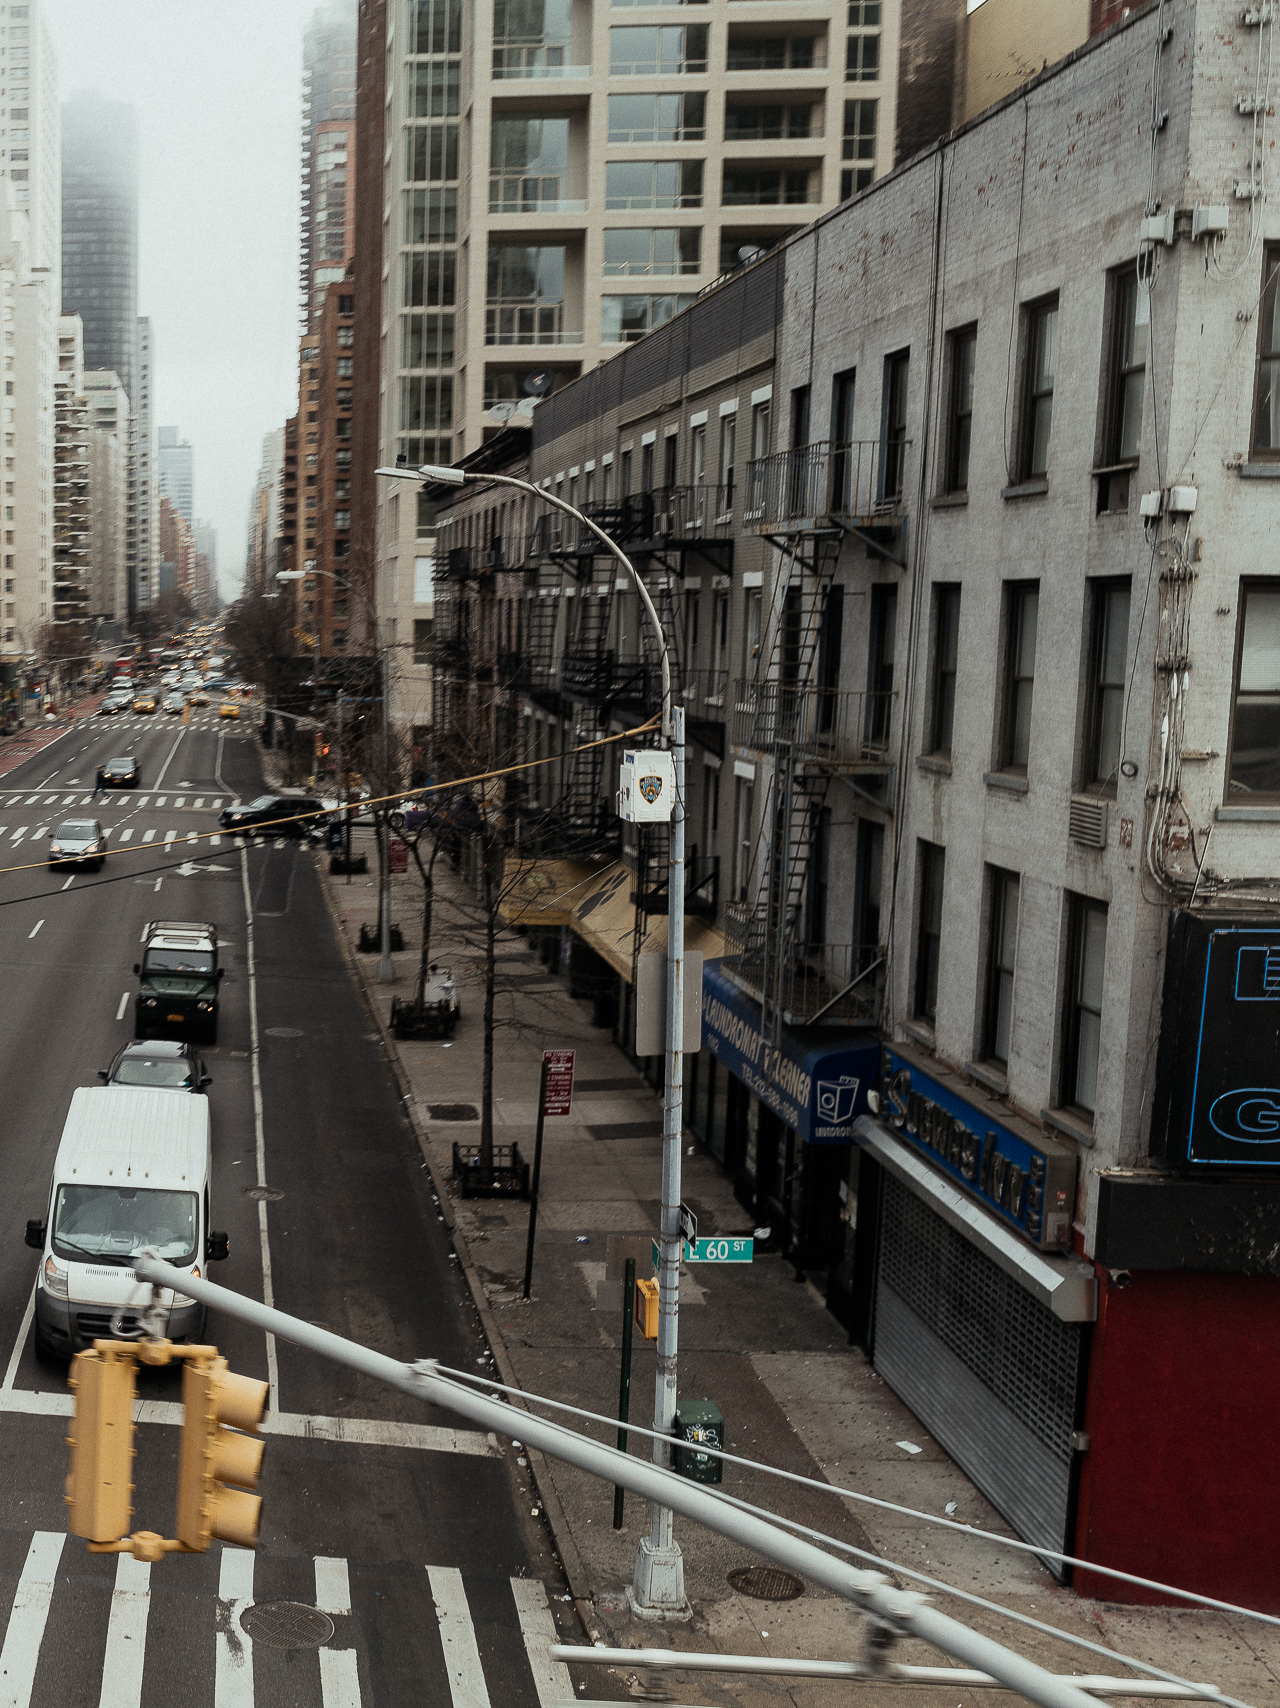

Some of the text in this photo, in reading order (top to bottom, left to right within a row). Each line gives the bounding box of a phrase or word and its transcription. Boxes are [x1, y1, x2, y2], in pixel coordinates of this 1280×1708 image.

[705, 994, 763, 1064] LAUNDROMAT
[770, 1049, 812, 1109] CLEANER
[706, 1240, 729, 1260] 60
[733, 1240, 746, 1251] ST
